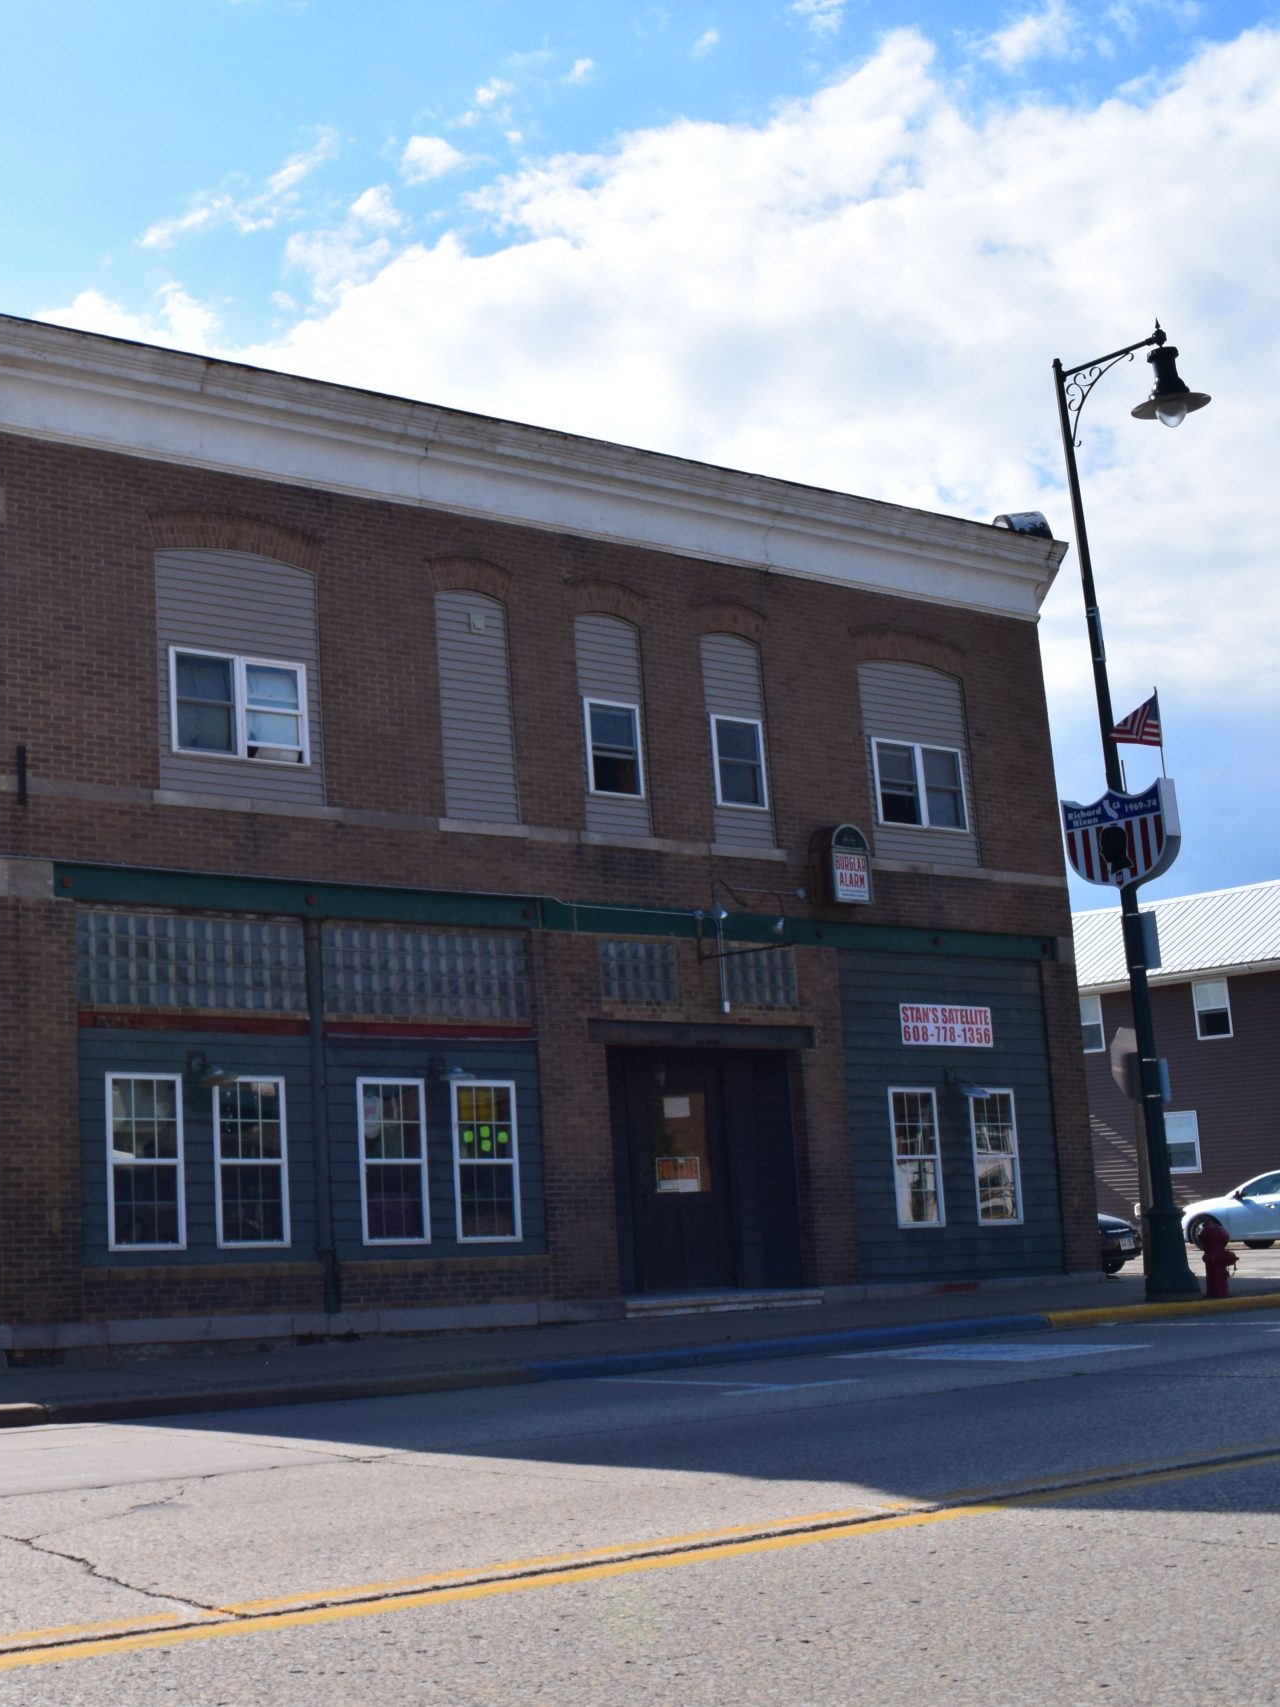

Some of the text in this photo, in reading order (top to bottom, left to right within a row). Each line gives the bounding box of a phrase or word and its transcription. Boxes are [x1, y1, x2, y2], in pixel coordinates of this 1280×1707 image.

[1067, 806, 1102, 820] Richard
[1124, 798, 1157, 813] 1969-74
[1073, 817, 1098, 828] Nixon
[835, 855, 867, 873] BURGLAR
[840, 871, 865, 888] ALARM
[901, 1006, 990, 1026] STAN'S SATELLITE
[903, 1025, 991, 1044] 608-778-1356
